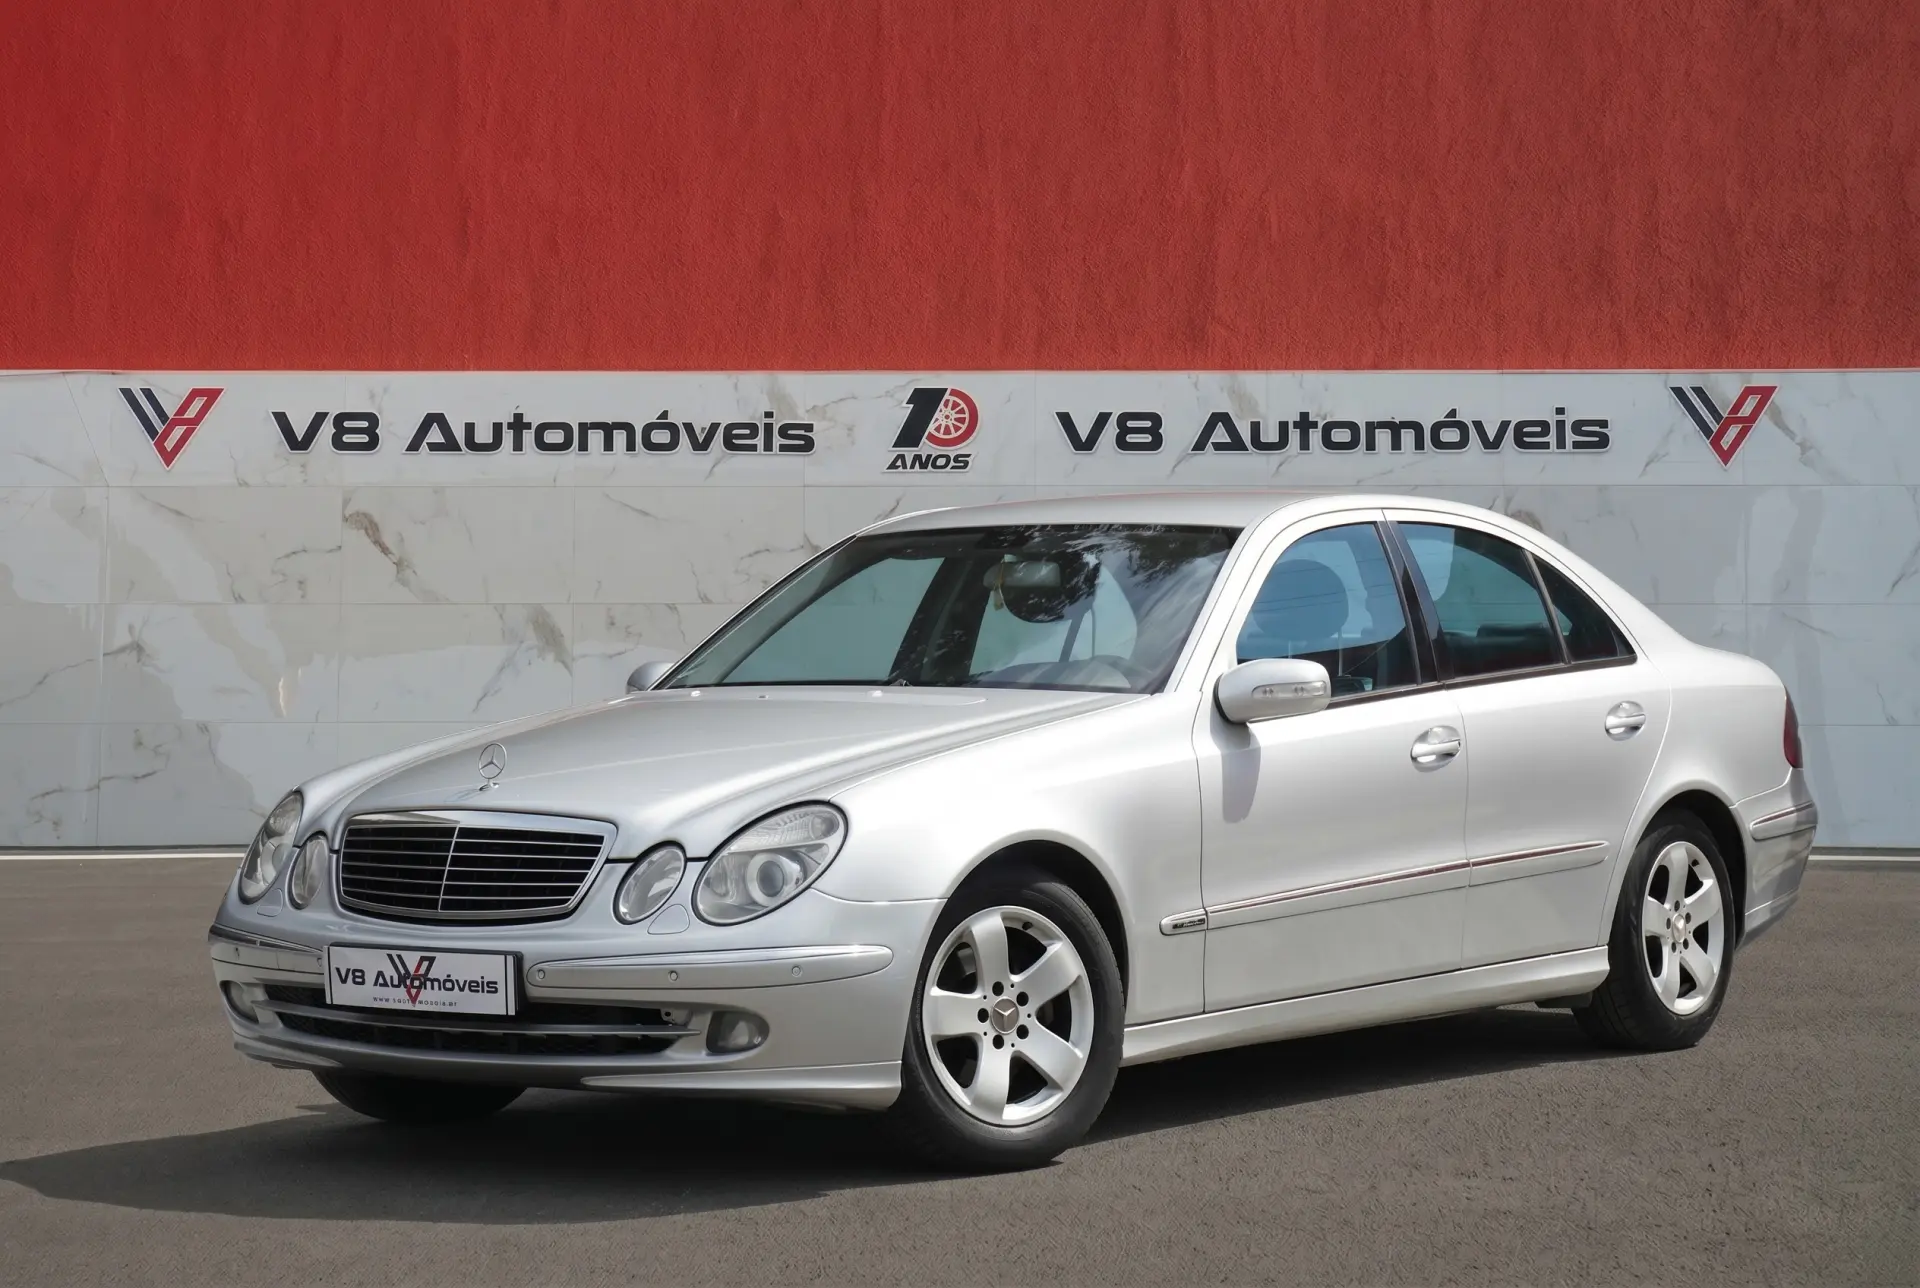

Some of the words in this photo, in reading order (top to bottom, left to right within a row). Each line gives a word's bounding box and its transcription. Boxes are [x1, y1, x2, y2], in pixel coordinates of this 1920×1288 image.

[272, 411, 380, 452] V8
[404, 409, 815, 453] Automóveis
[1056, 411, 1164, 452] V8
[1191, 406, 1610, 452] Automóveis
[886, 453, 972, 470] ANOS
[335, 967, 366, 986] V8
[373, 971, 499, 994] Automóveis
